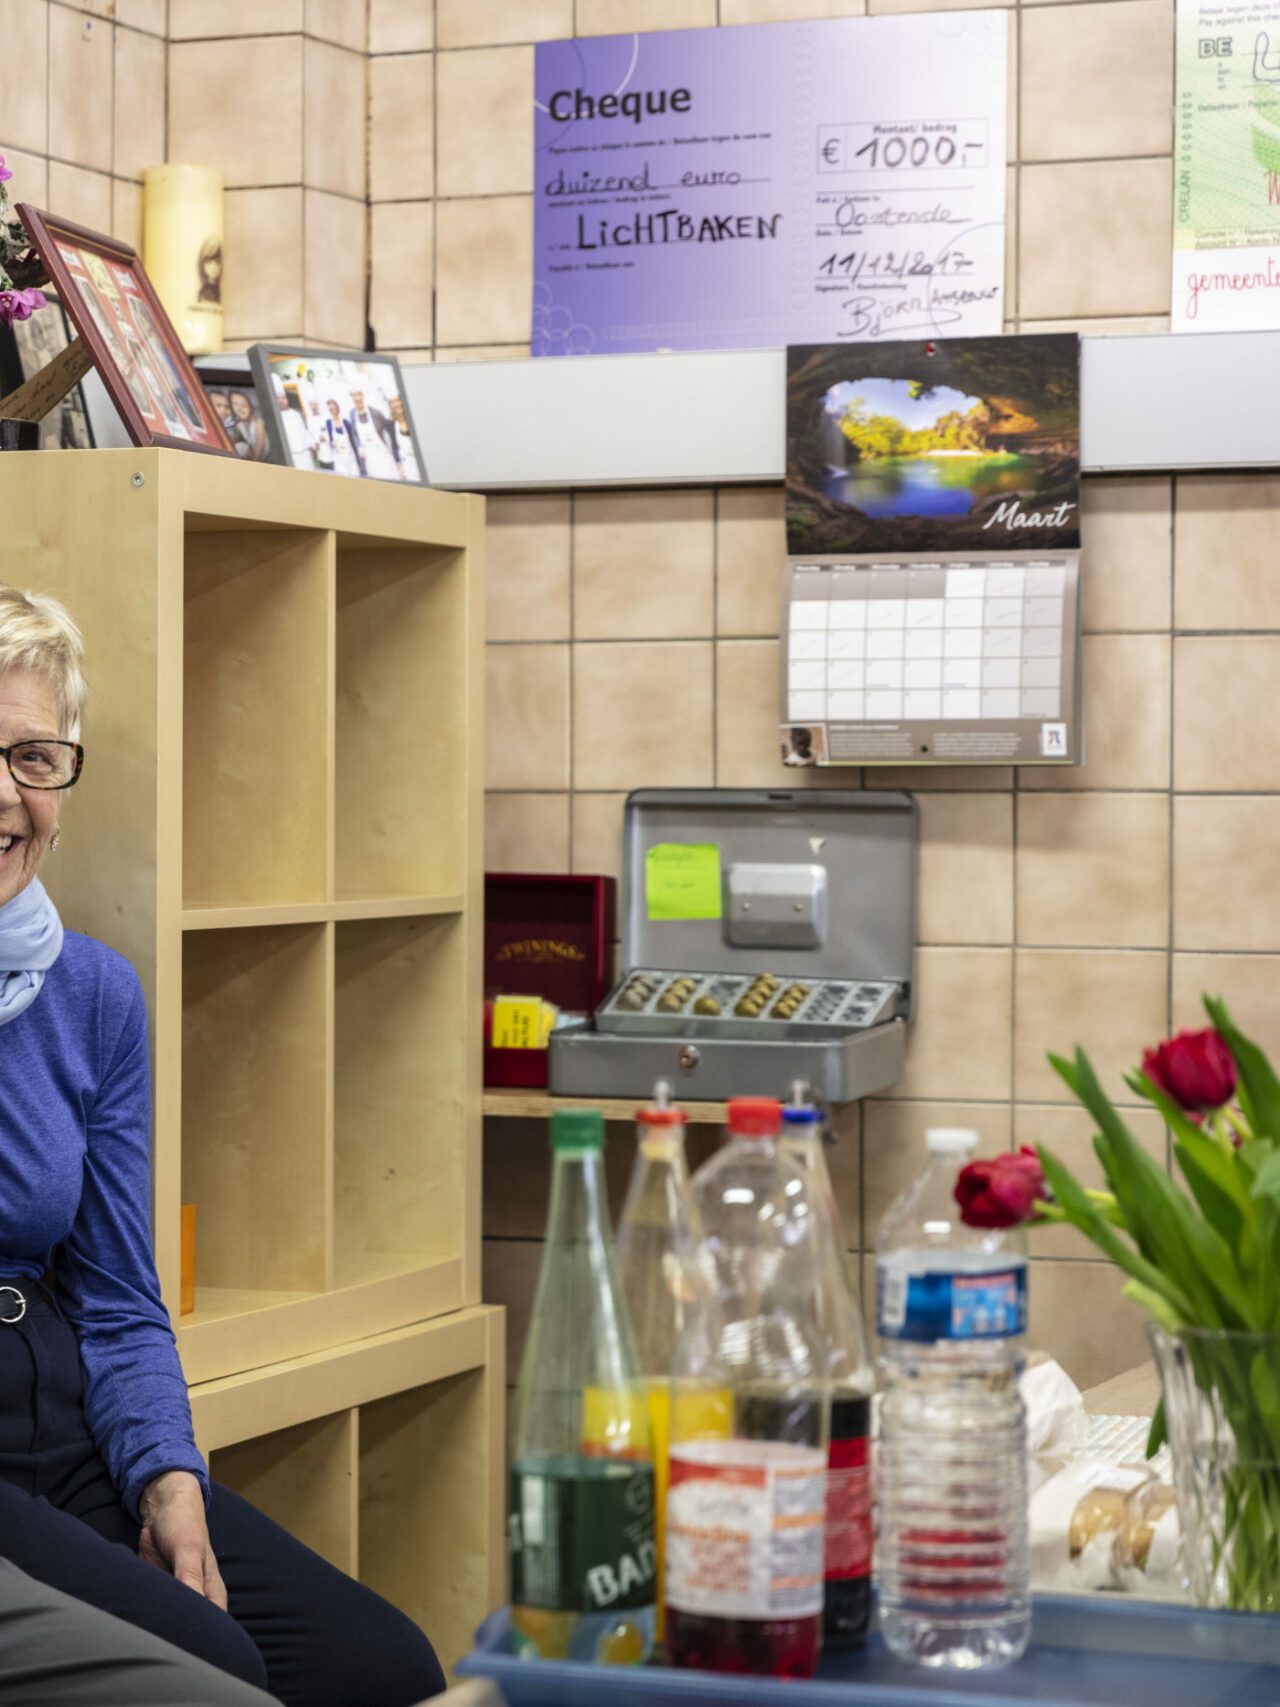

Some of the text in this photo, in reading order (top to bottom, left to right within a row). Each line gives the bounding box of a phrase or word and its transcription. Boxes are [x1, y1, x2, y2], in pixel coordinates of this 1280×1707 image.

[1198, 37, 1232, 58] BE
[549, 87, 691, 124] Cheque
[822, 137, 840, 164] €
[544, 160, 657, 197] duizend
[1179, 169, 1191, 223] CRELAN
[983, 501, 1077, 530] Maart
